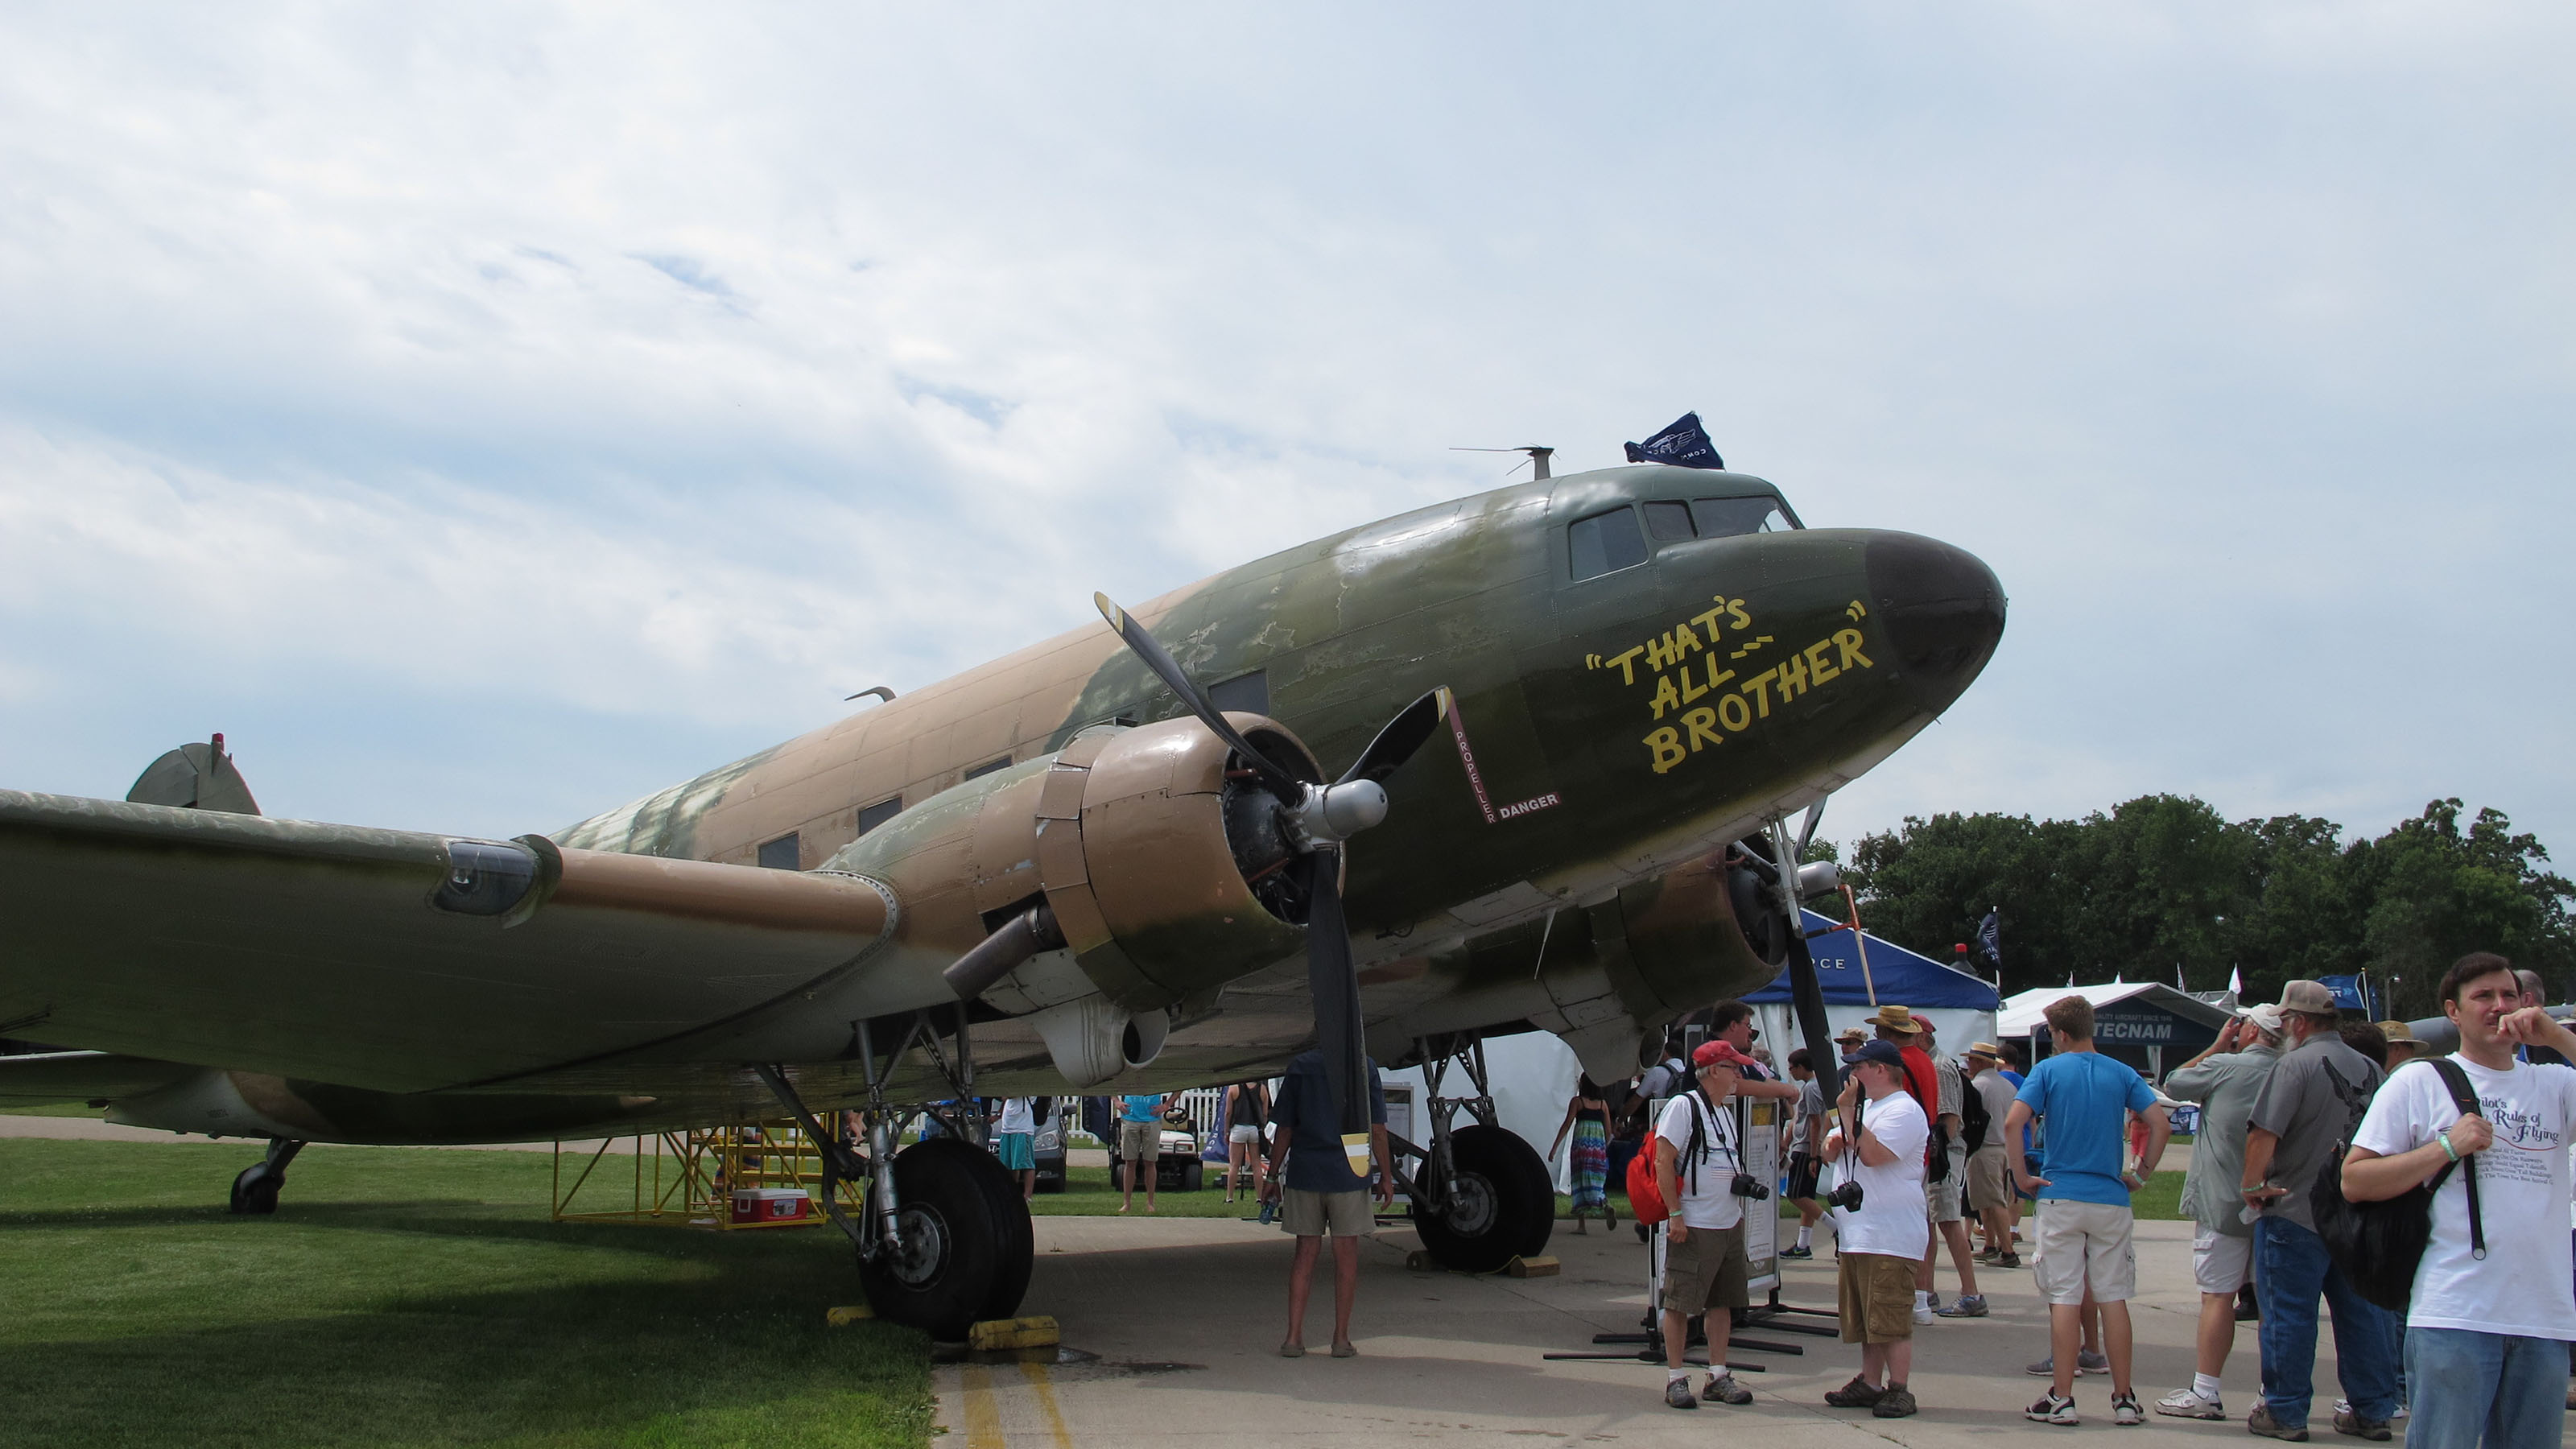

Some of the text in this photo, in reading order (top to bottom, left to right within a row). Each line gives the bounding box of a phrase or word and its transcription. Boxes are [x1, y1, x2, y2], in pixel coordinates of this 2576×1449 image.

[1455, 730, 1496, 824] PROPELLER
[1499, 793, 1559, 819] DANGER
[2092, 1022, 2172, 1039] TECNAM
[2481, 1096, 2508, 1109] ilot's
[2492, 1108, 2528, 1129] Rules
[2530, 1113, 2541, 1127] of
[2512, 1124, 2559, 1145] Flying
